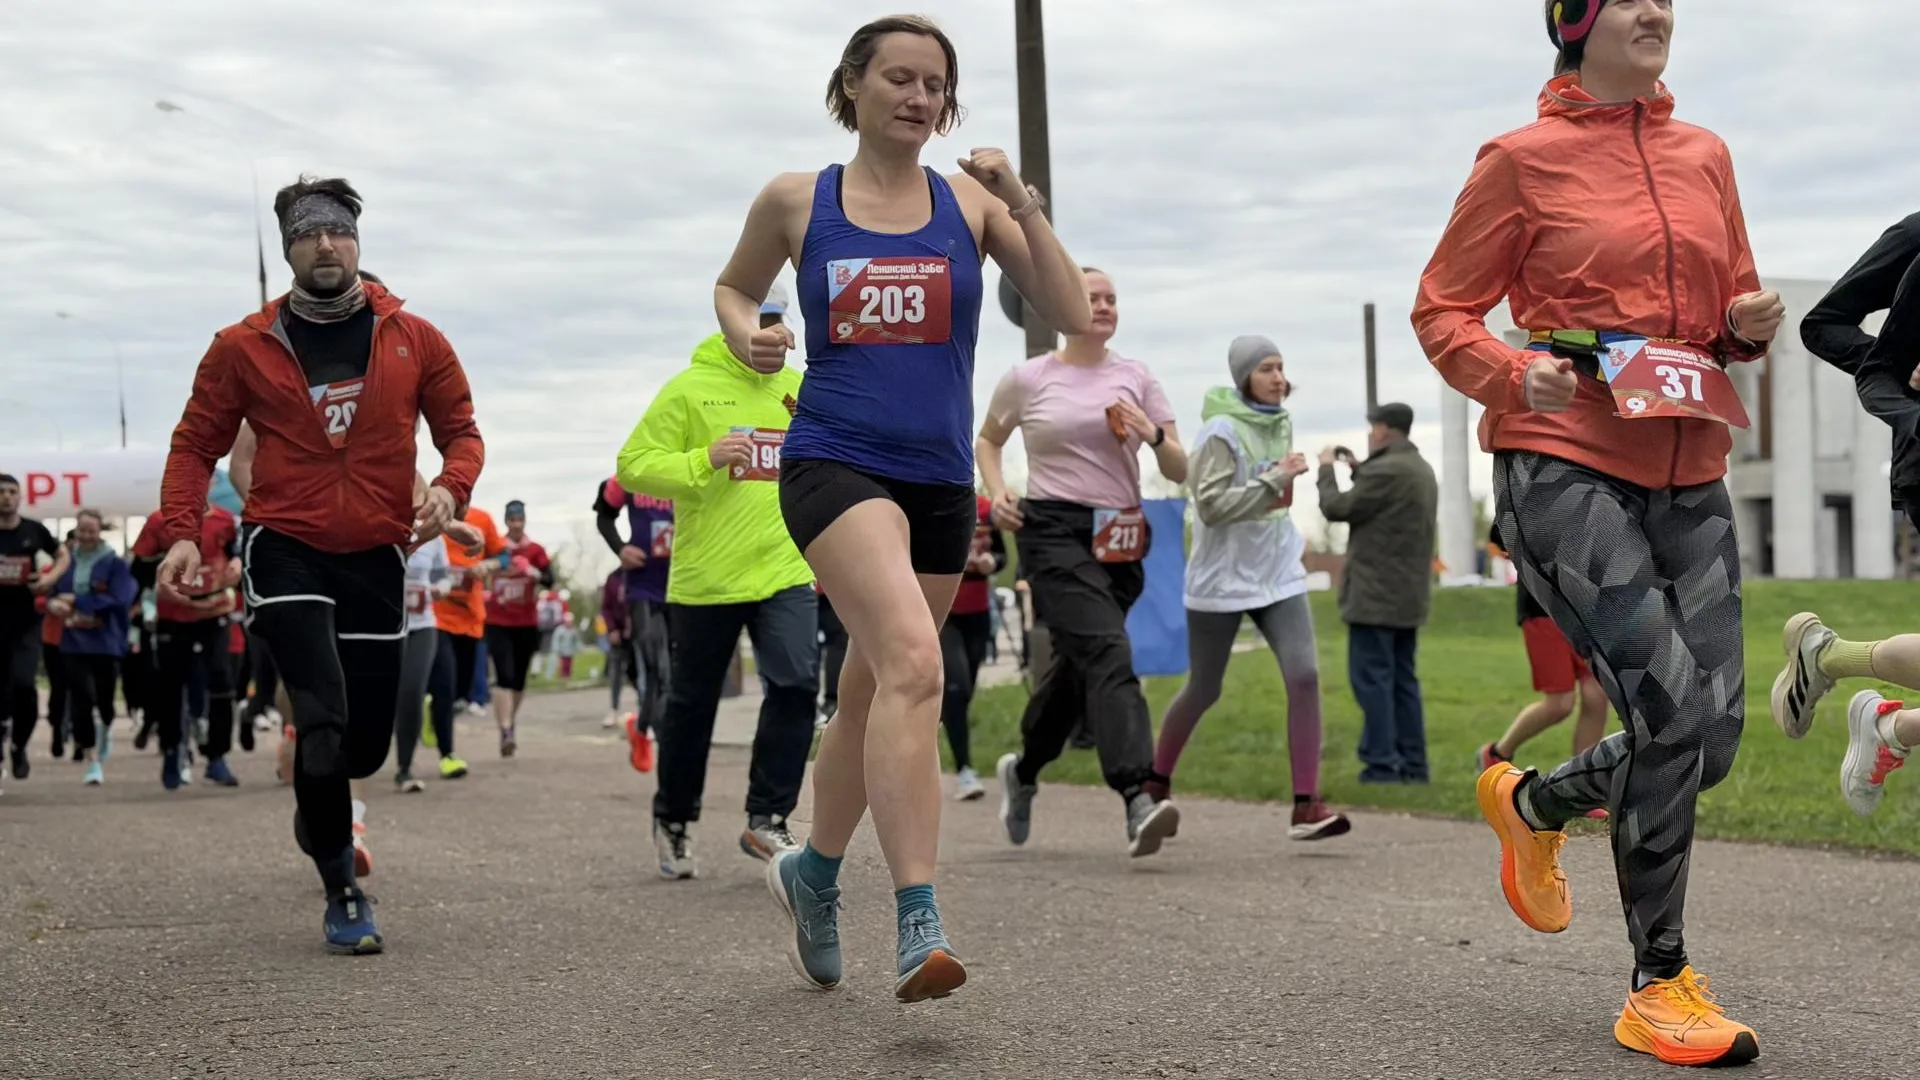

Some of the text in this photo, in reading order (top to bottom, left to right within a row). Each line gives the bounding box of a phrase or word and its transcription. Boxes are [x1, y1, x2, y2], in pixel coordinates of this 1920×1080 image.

[867, 263, 917, 274] Ленинский
[860, 285, 926, 324] 203
[1655, 364, 1704, 402] 37
[1107, 525, 1140, 551] 213
